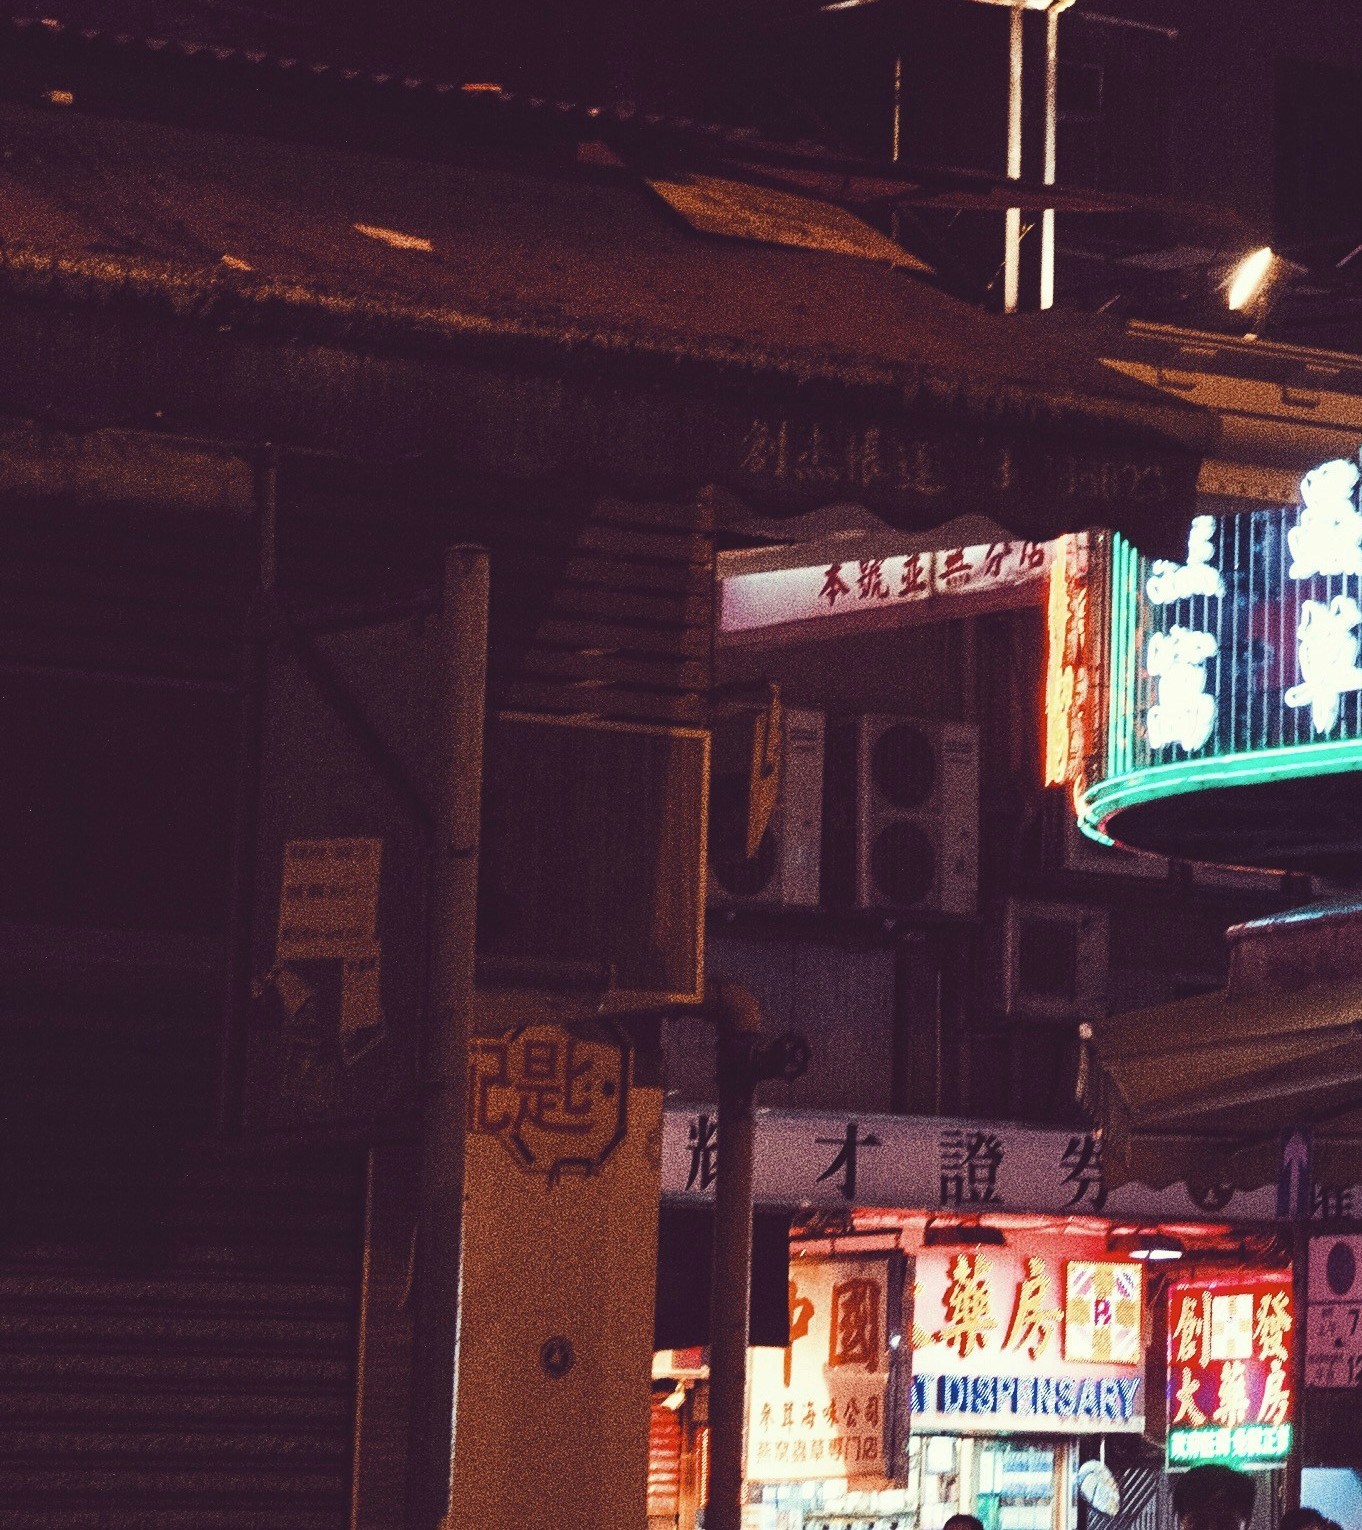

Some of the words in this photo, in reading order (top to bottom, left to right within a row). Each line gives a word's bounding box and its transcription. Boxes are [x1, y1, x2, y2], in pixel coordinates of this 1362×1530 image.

[911, 1252, 1065, 1361] 藥房
[1348, 1308, 1360, 1336] 7
[938, 1373, 1142, 1423] DISPENSARY
